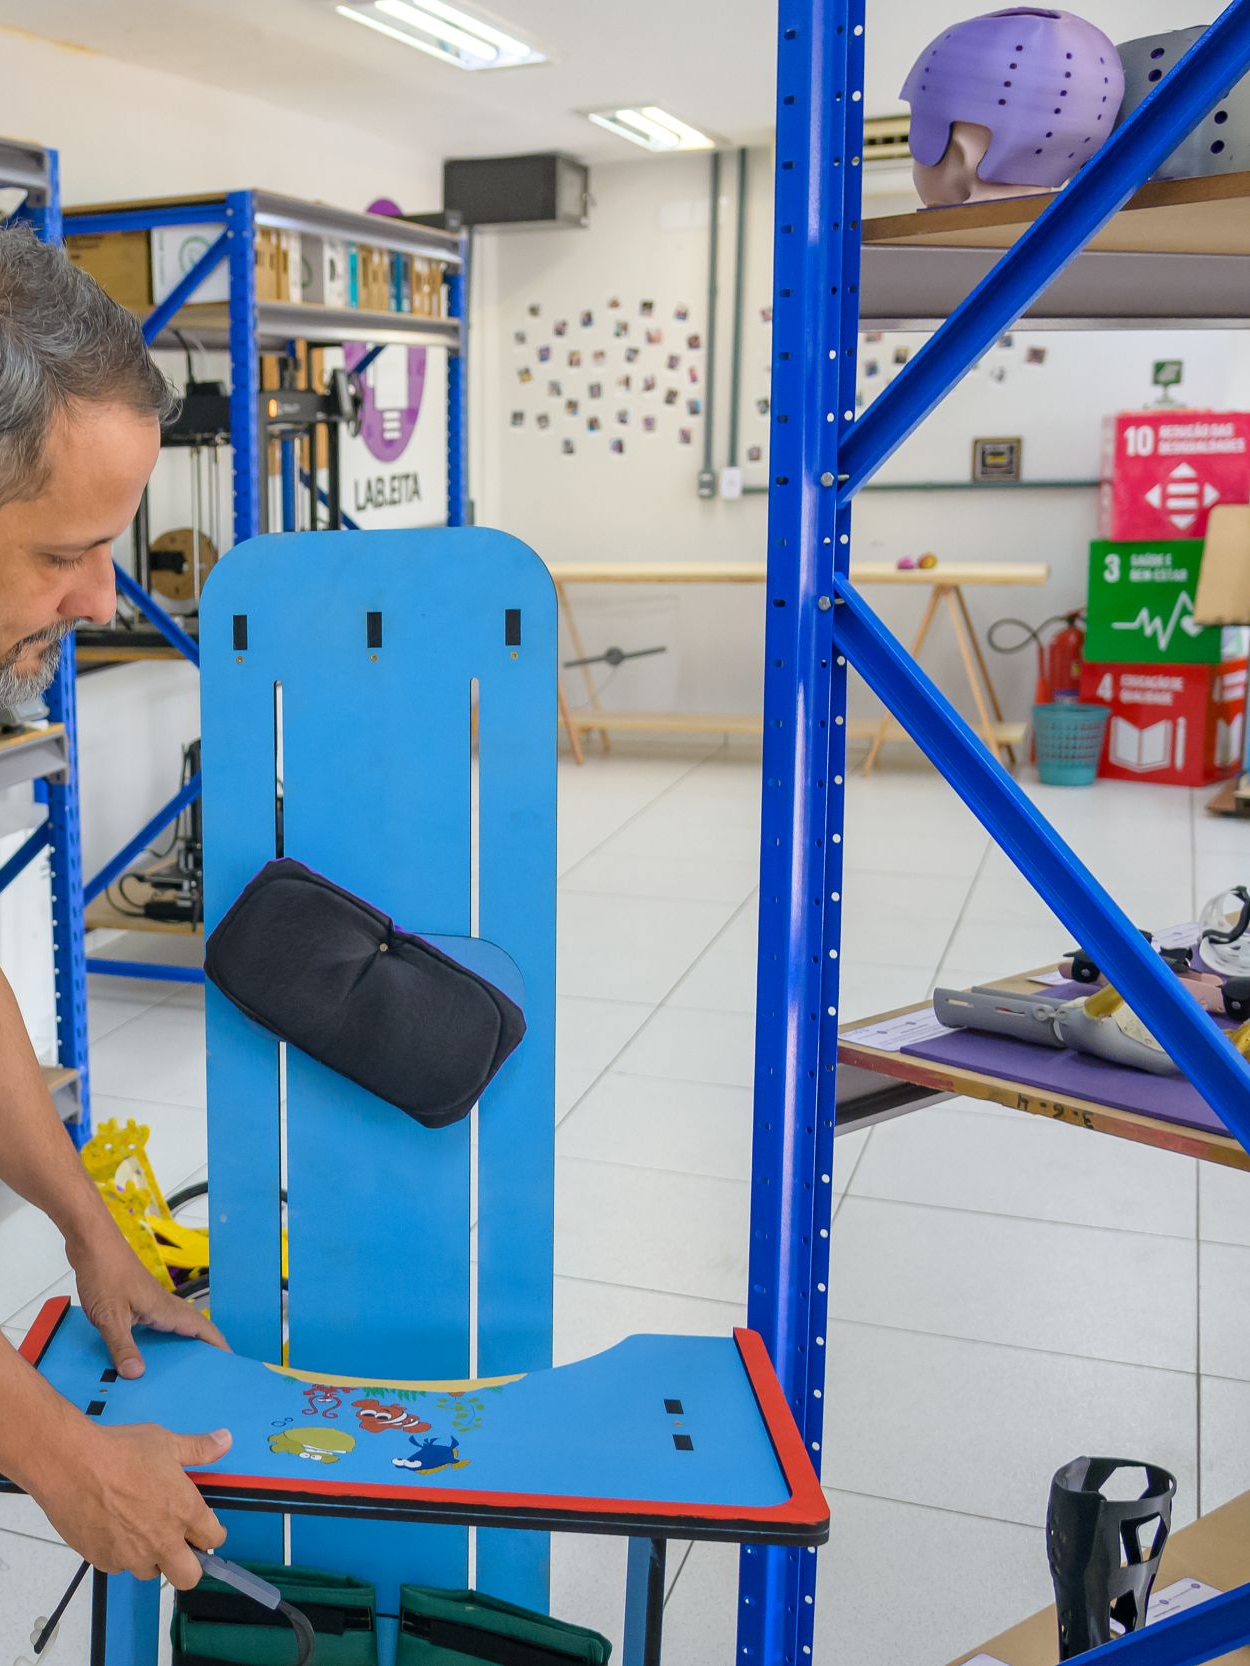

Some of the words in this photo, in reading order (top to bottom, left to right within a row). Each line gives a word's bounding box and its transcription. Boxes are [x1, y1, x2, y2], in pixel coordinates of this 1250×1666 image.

[1124, 425, 1154, 457] 10
[354, 473, 422, 511] LAB.EITA
[1103, 553, 1120, 583] 3
[1096, 672, 1113, 702] 4
